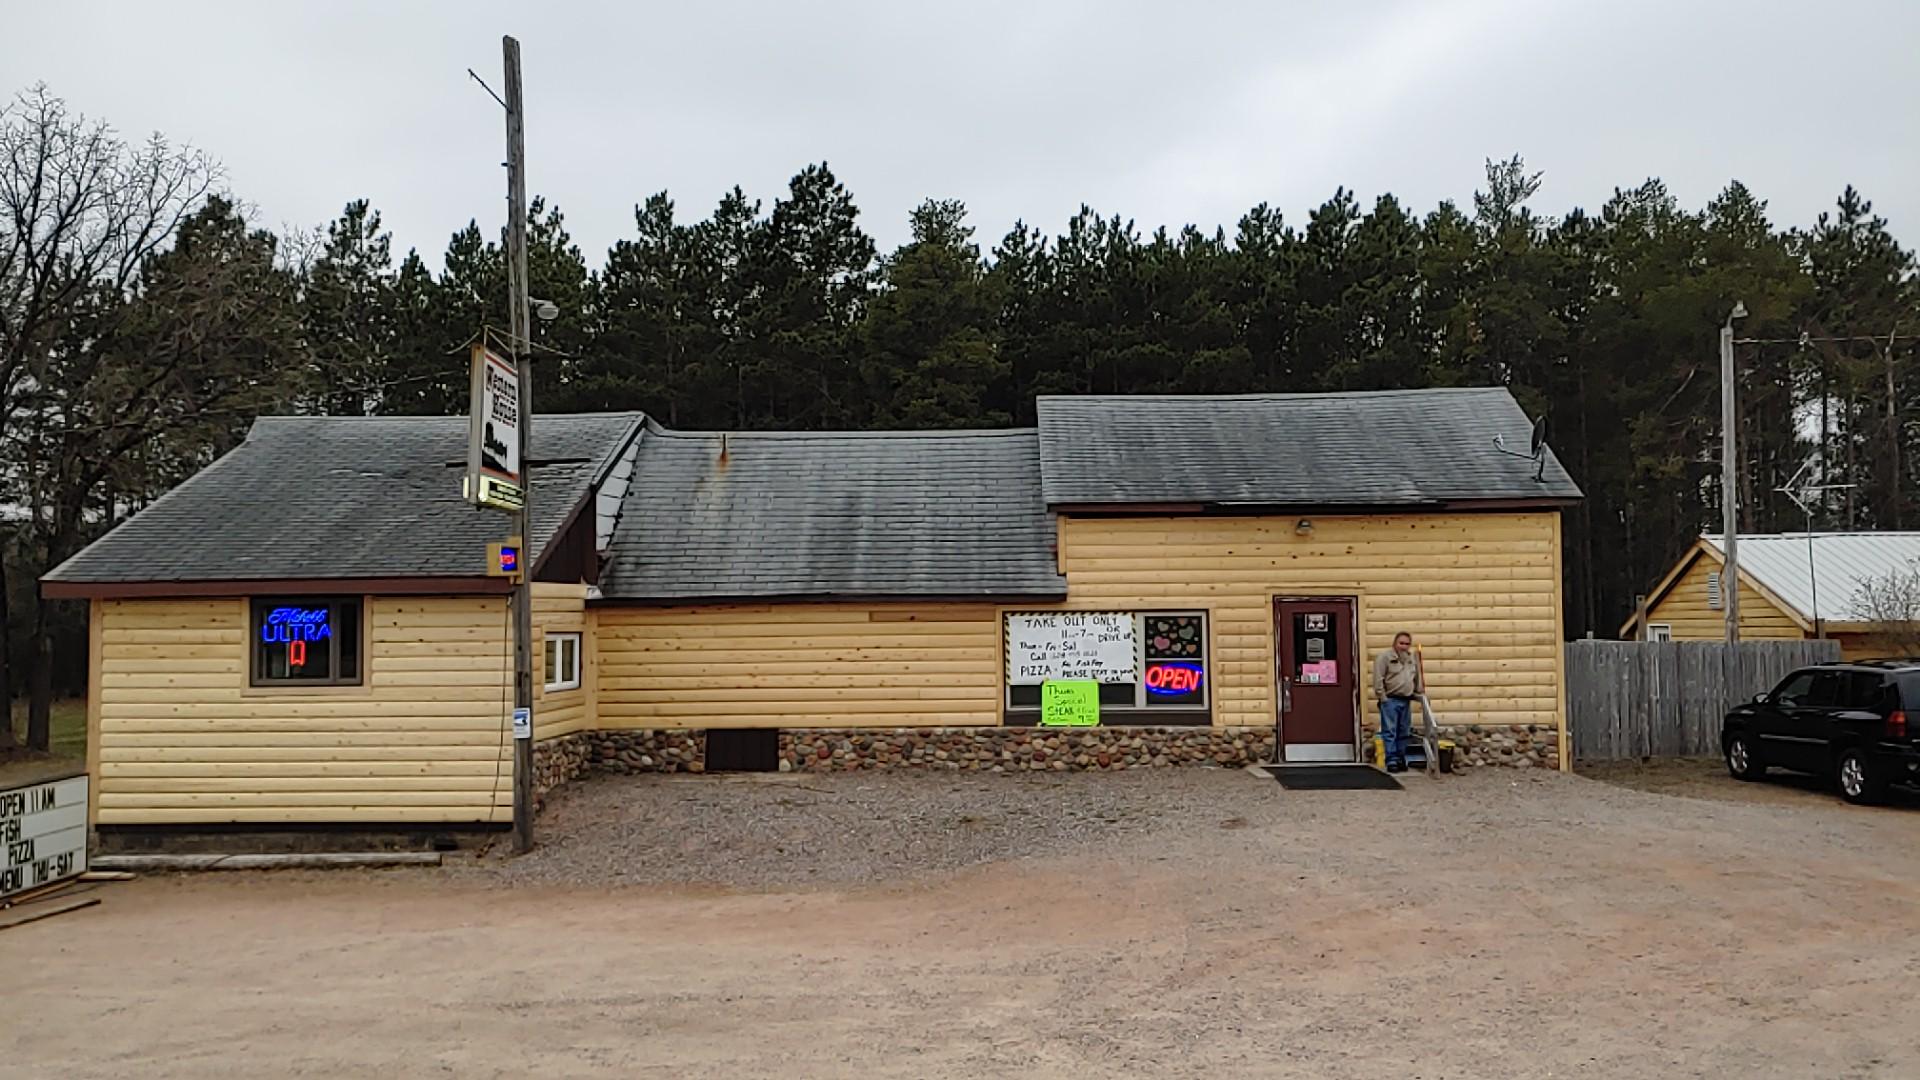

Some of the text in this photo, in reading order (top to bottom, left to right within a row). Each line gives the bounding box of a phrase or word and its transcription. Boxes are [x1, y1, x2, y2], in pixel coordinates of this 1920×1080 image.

[1024, 615, 1117, 628] TAKE OUT ONLY
[263, 623, 331, 642] ULTRA
[1030, 651, 1046, 660] Call
[1020, 665, 1052, 677] PIZZA
[1062, 669, 1088, 678] PLEASE
[1146, 665, 1200, 692] OPEN
[0, 793, 26, 818] OPEN
